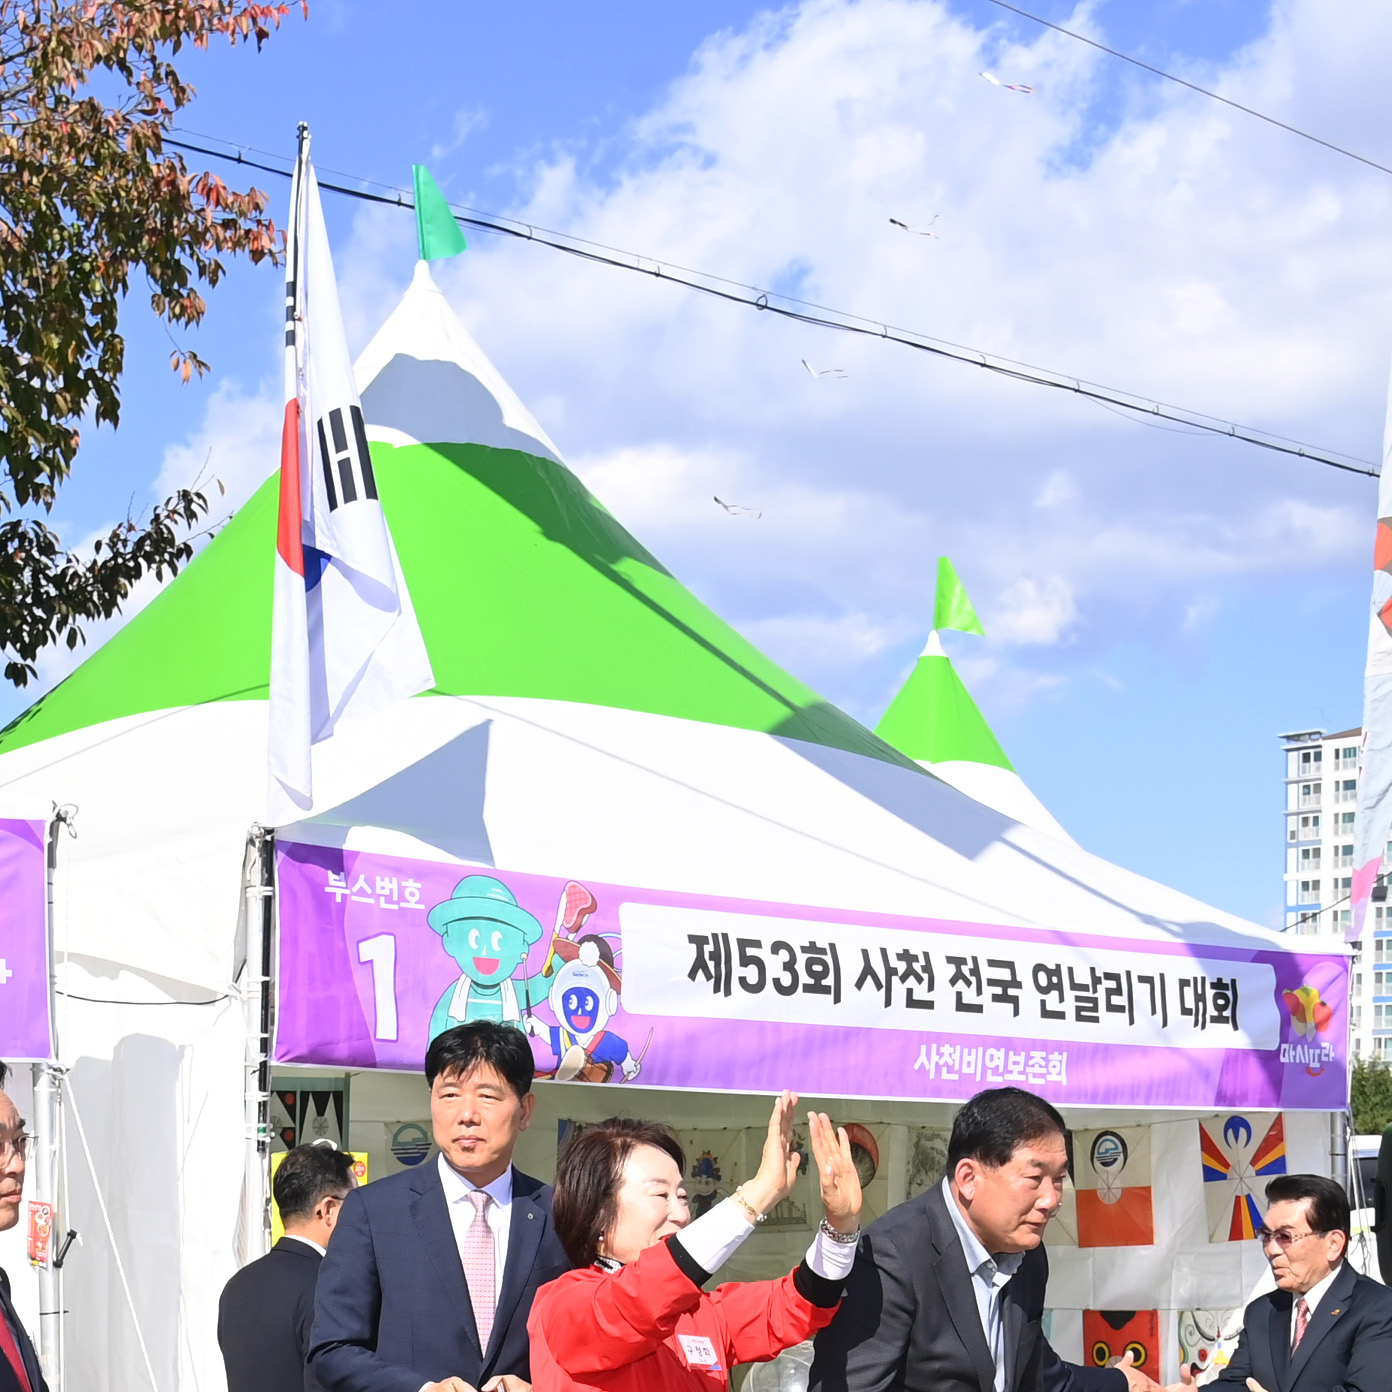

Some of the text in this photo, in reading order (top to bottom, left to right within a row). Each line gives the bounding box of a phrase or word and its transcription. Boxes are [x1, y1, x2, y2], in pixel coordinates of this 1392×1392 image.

[324, 869, 426, 910] 부스번호
[358, 932, 398, 1042] 1
[687, 932, 1240, 1032] 제53회 사천 전국 연날리기 대회
[912, 1042, 1069, 1087] 사천비연보존회
